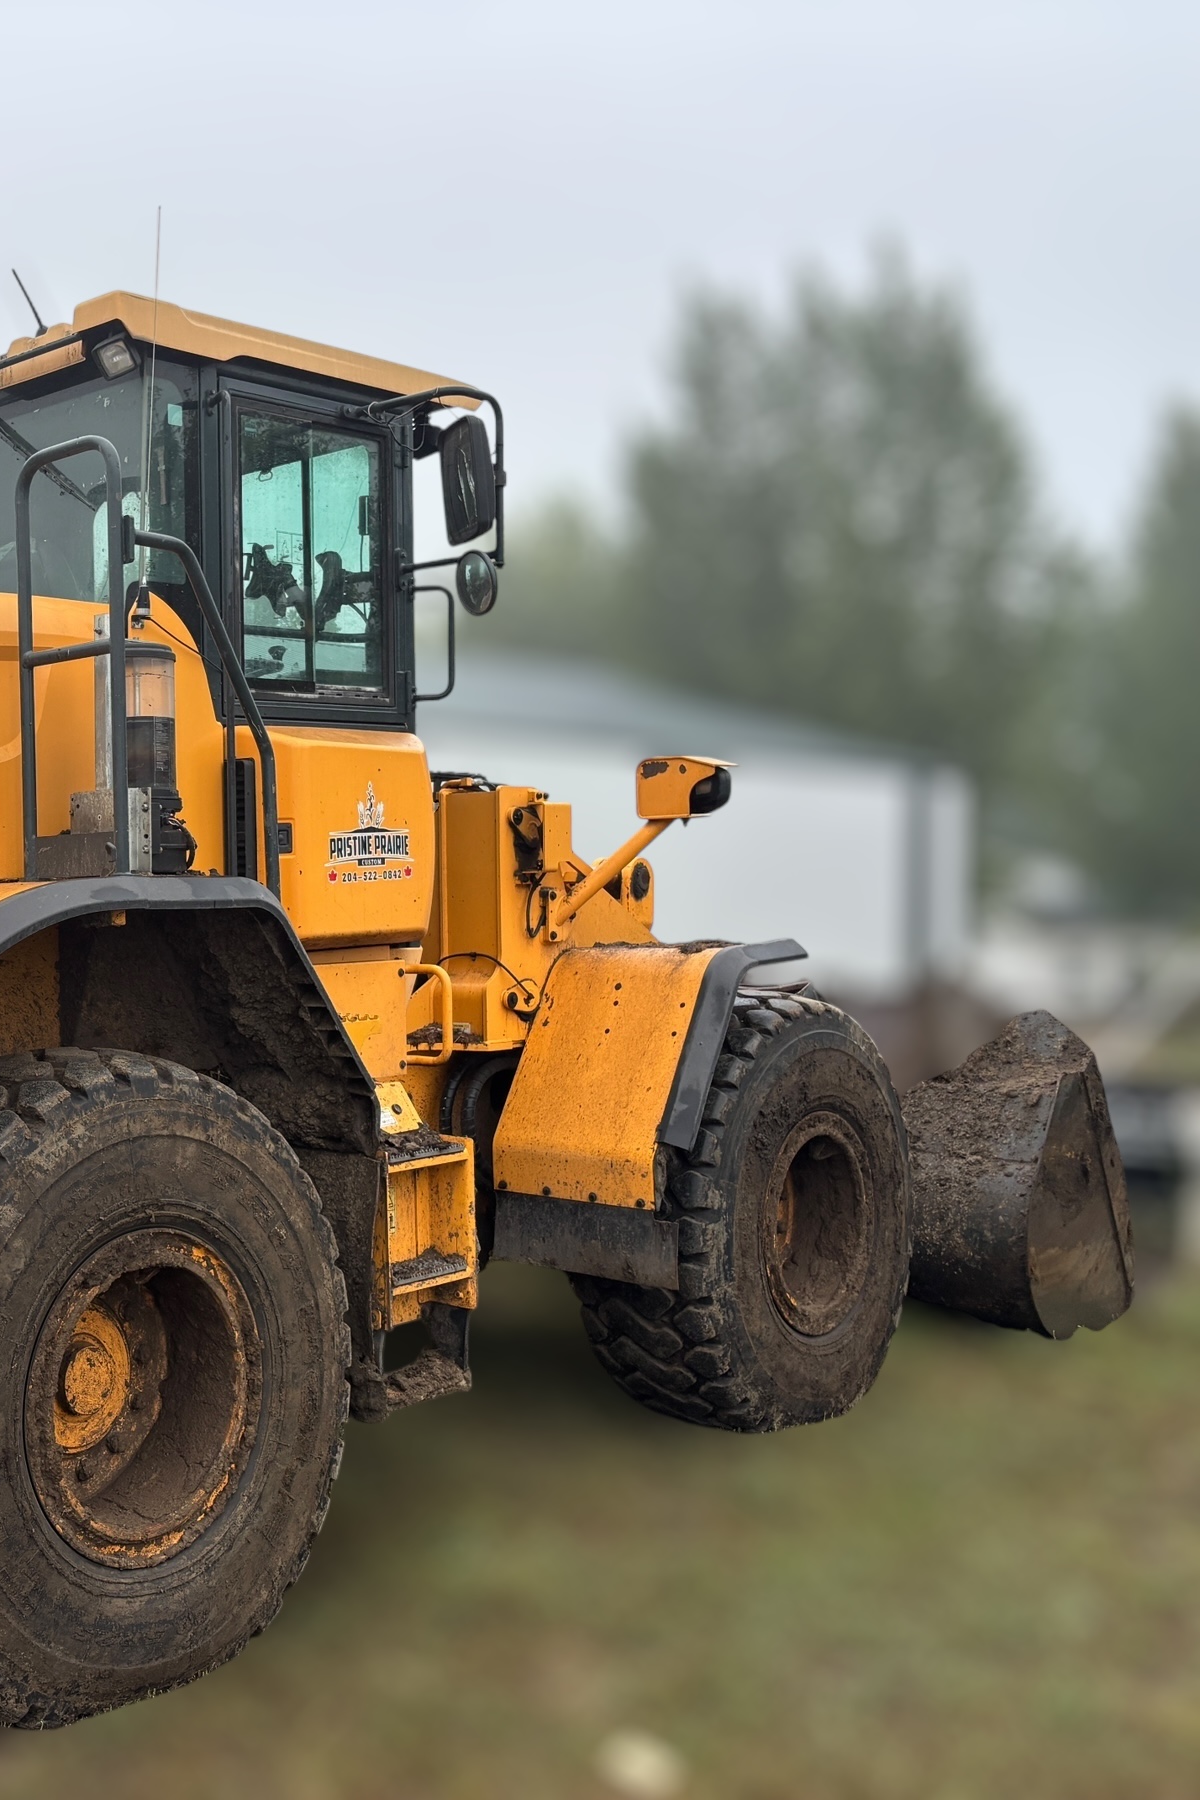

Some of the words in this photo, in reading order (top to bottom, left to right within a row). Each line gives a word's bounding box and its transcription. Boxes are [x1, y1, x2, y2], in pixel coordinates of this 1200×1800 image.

[329, 835, 373, 860] PRISTINE
[374, 834, 409, 856] PRAIRIE
[361, 858, 382, 866] CUSTOM
[341, 869, 402, 883] 204-522-0842
